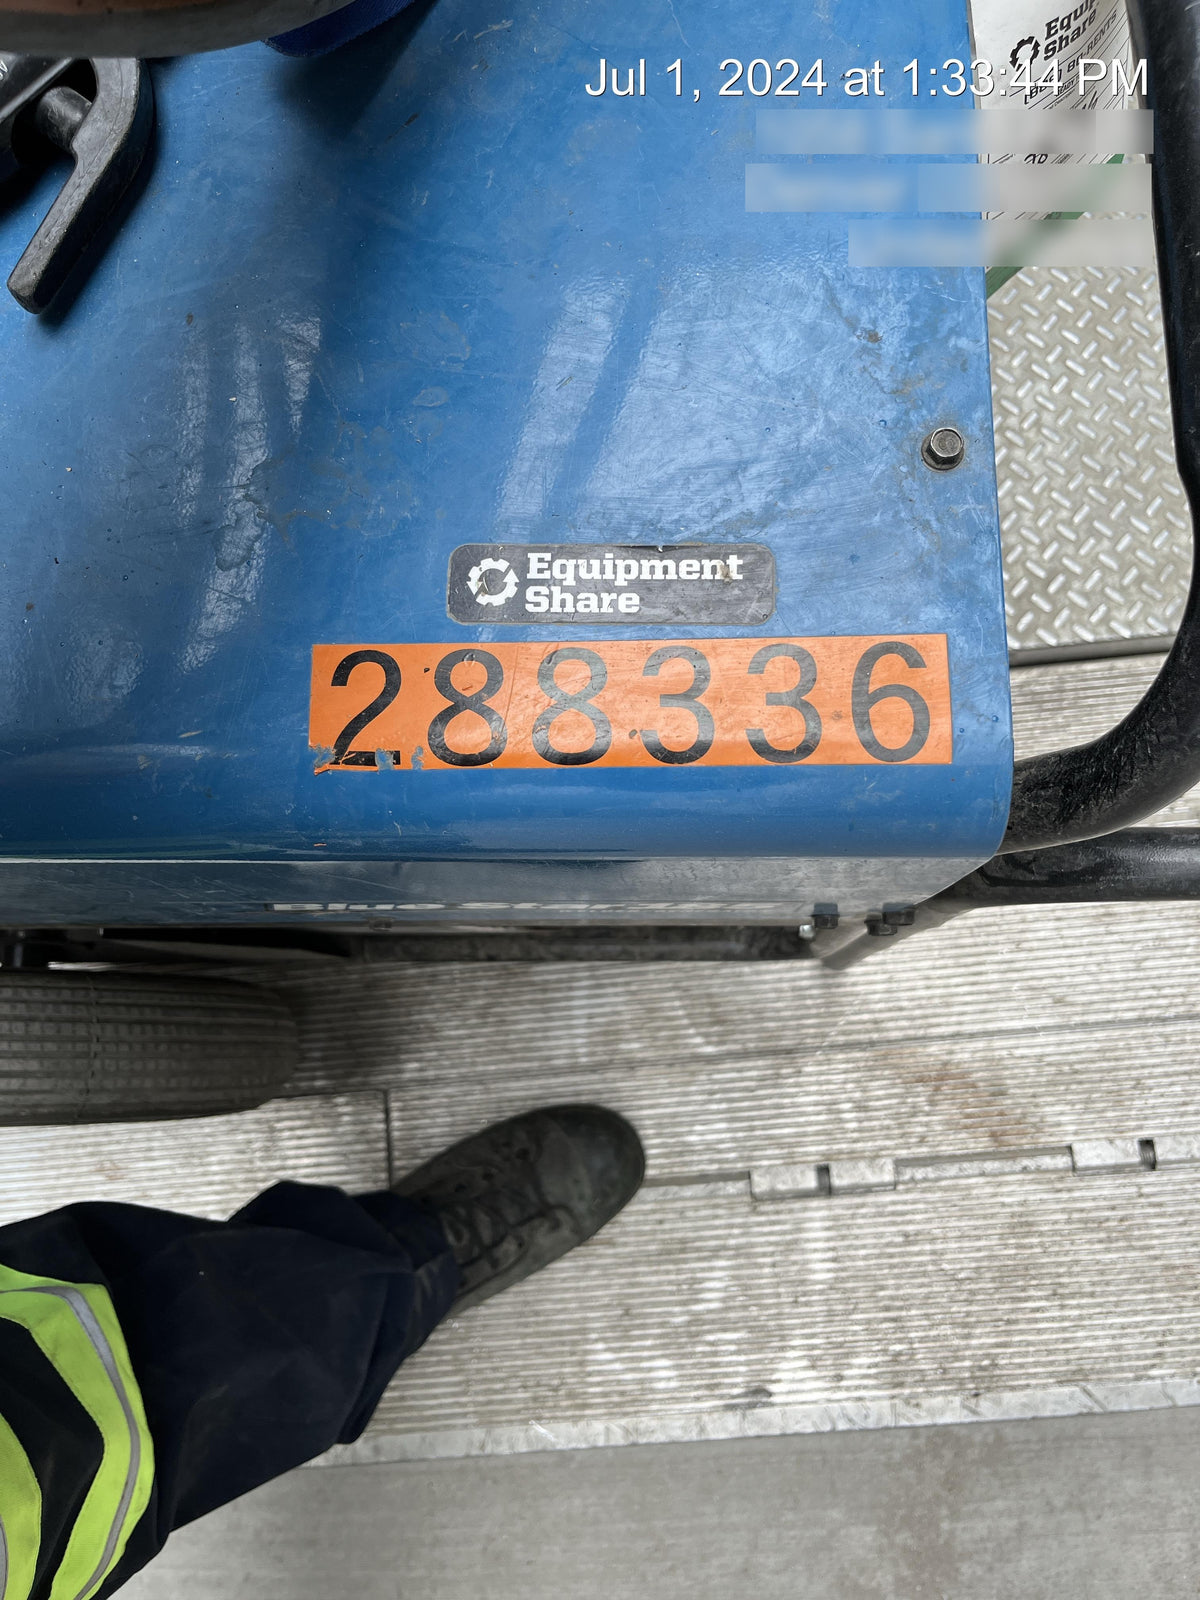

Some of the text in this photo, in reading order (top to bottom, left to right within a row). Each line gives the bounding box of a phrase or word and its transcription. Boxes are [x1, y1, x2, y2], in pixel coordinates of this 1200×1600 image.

[1043, 9, 1097, 61] Share
[527, 553, 743, 583] Equipment
[525, 587, 641, 614] Share
[330, 641, 932, 766] 288336
